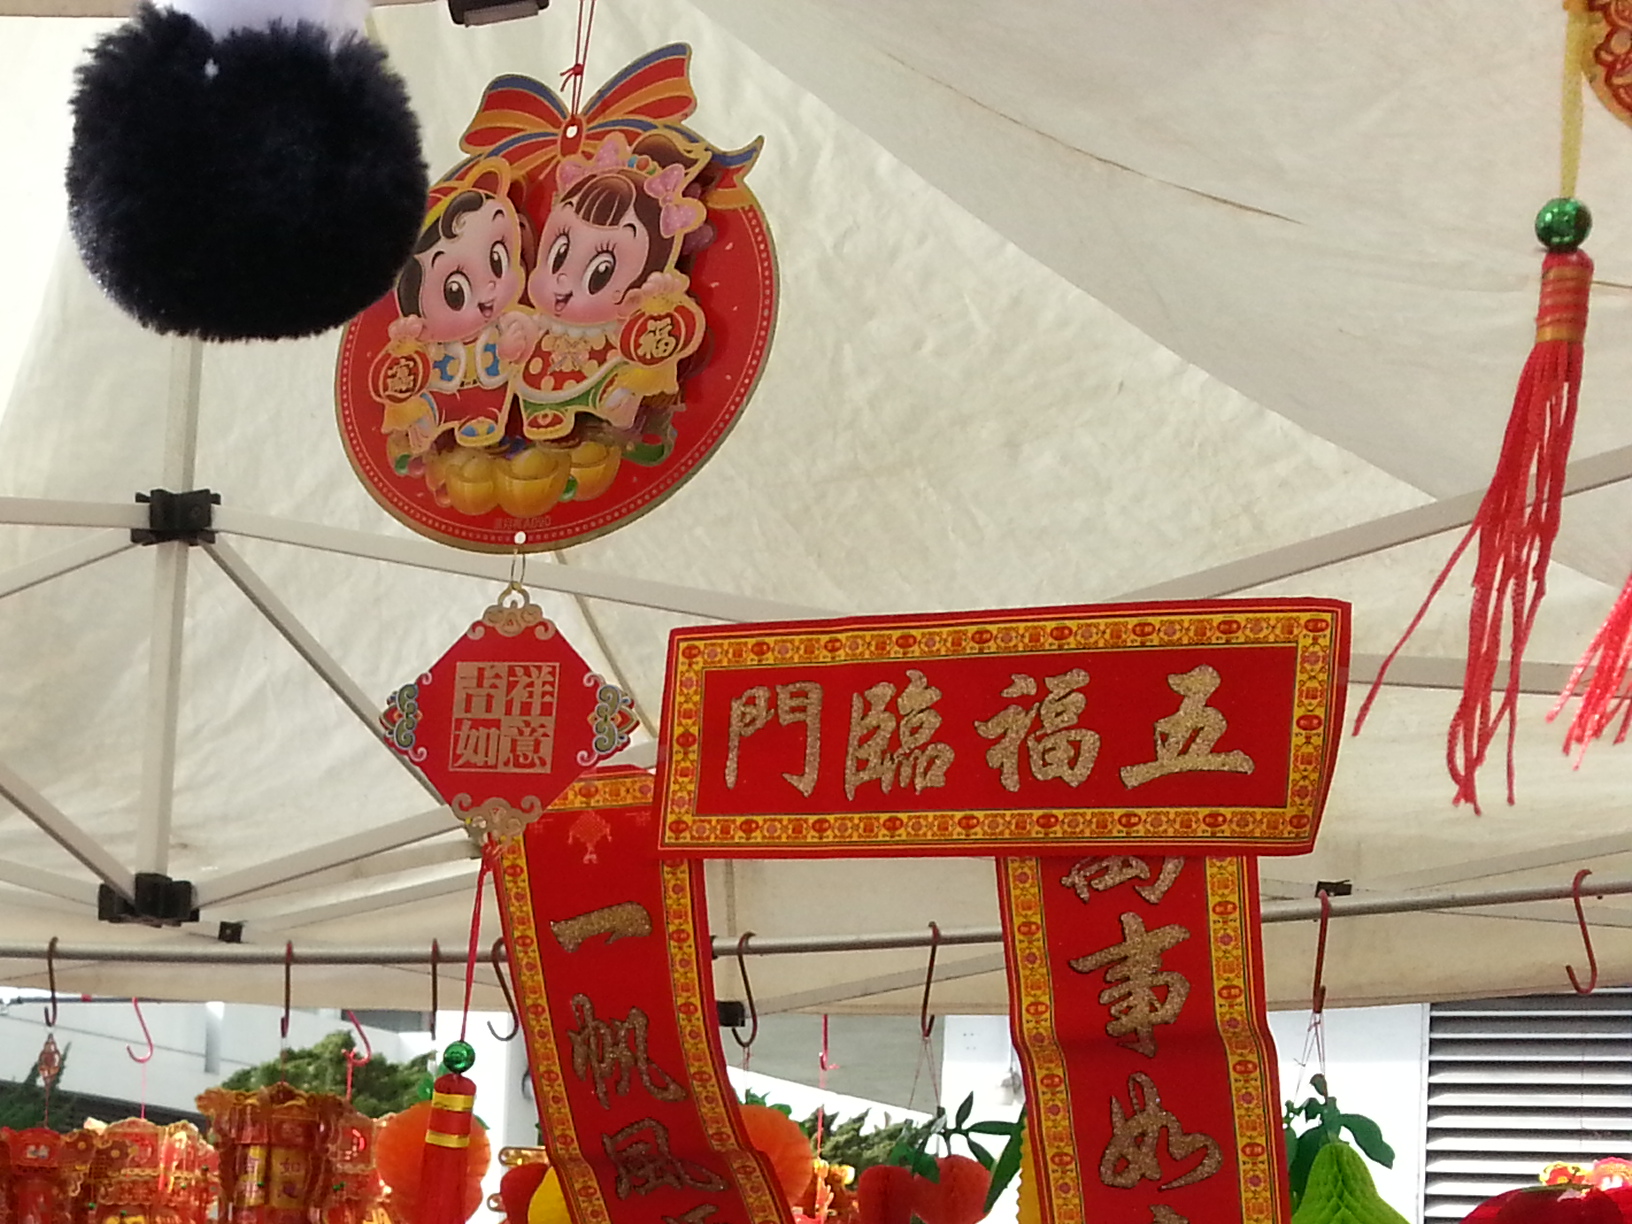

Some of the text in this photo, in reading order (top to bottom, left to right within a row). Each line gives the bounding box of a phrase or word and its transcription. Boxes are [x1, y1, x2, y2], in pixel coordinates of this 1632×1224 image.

[637, 316, 679, 359] 福
[457, 662, 556, 718] 吉祥
[454, 718, 552, 771] 如意
[723, 664, 1255, 801] 五福臨門
